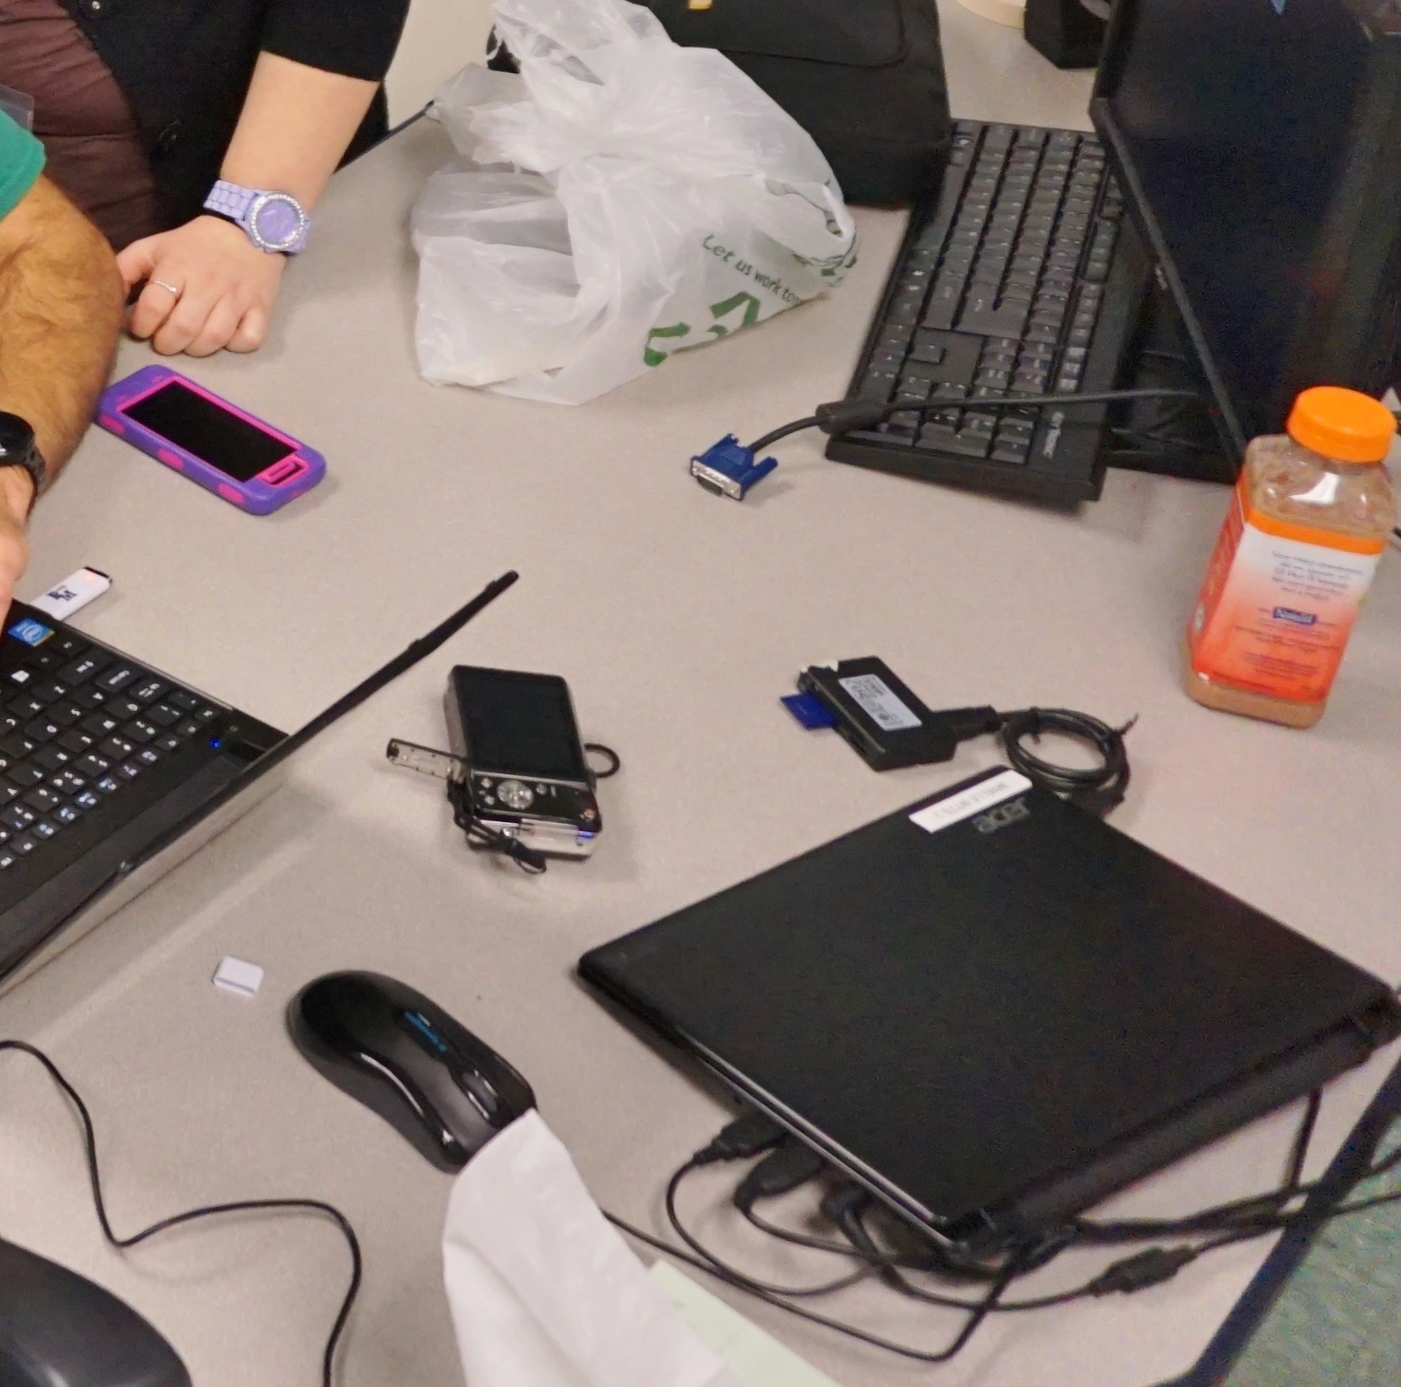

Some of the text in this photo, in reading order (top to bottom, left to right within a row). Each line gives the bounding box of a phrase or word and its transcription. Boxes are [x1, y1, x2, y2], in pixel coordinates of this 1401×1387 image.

[702, 234, 736, 263] Let
[735, 260, 753, 276] us
[754, 270, 782, 295] work
